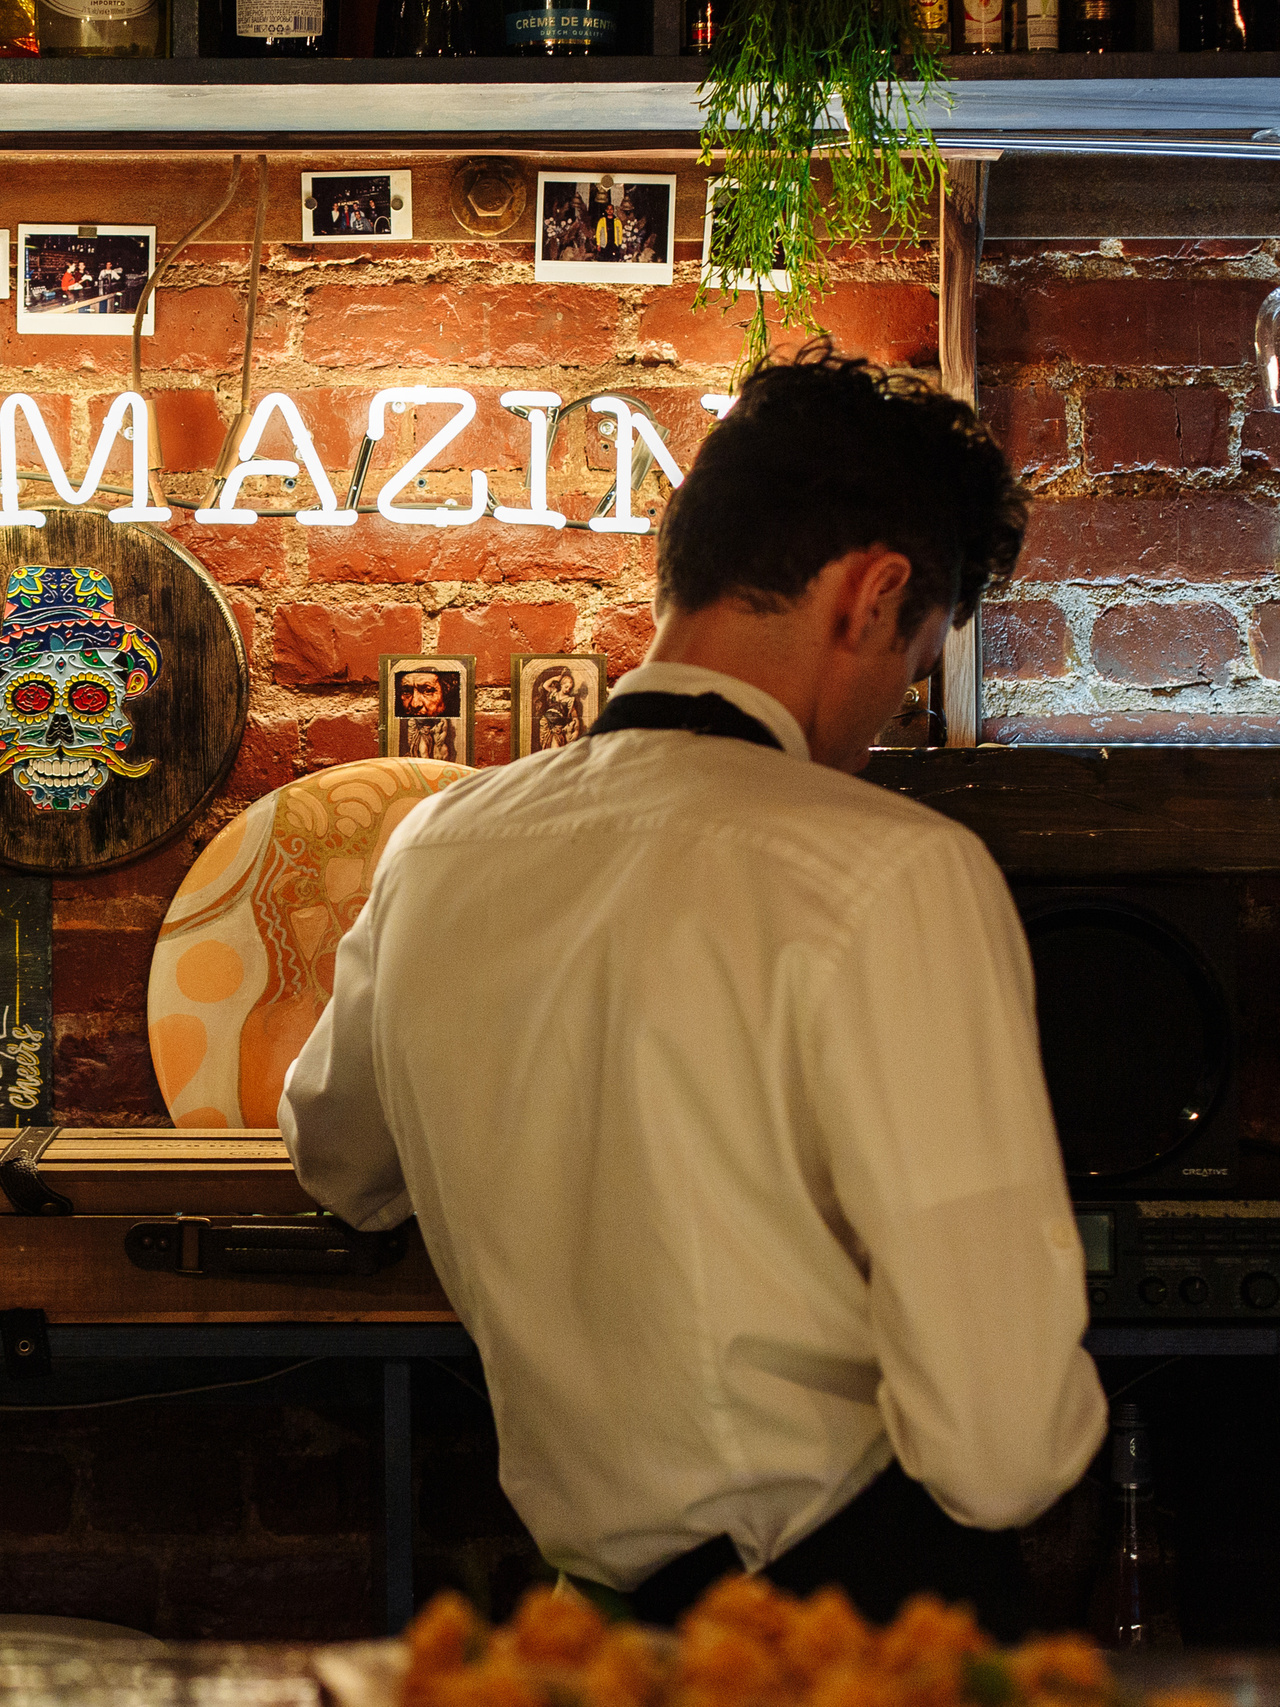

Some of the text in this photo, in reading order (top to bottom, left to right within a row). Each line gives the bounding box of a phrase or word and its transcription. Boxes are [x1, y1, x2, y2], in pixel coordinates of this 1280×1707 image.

[516, 15, 556, 30] CRÈME
[561, 16, 579, 27] DE
[7, 1023, 45, 1110] Cheers
[1182, 1168, 1228, 1177] CREATIVE
